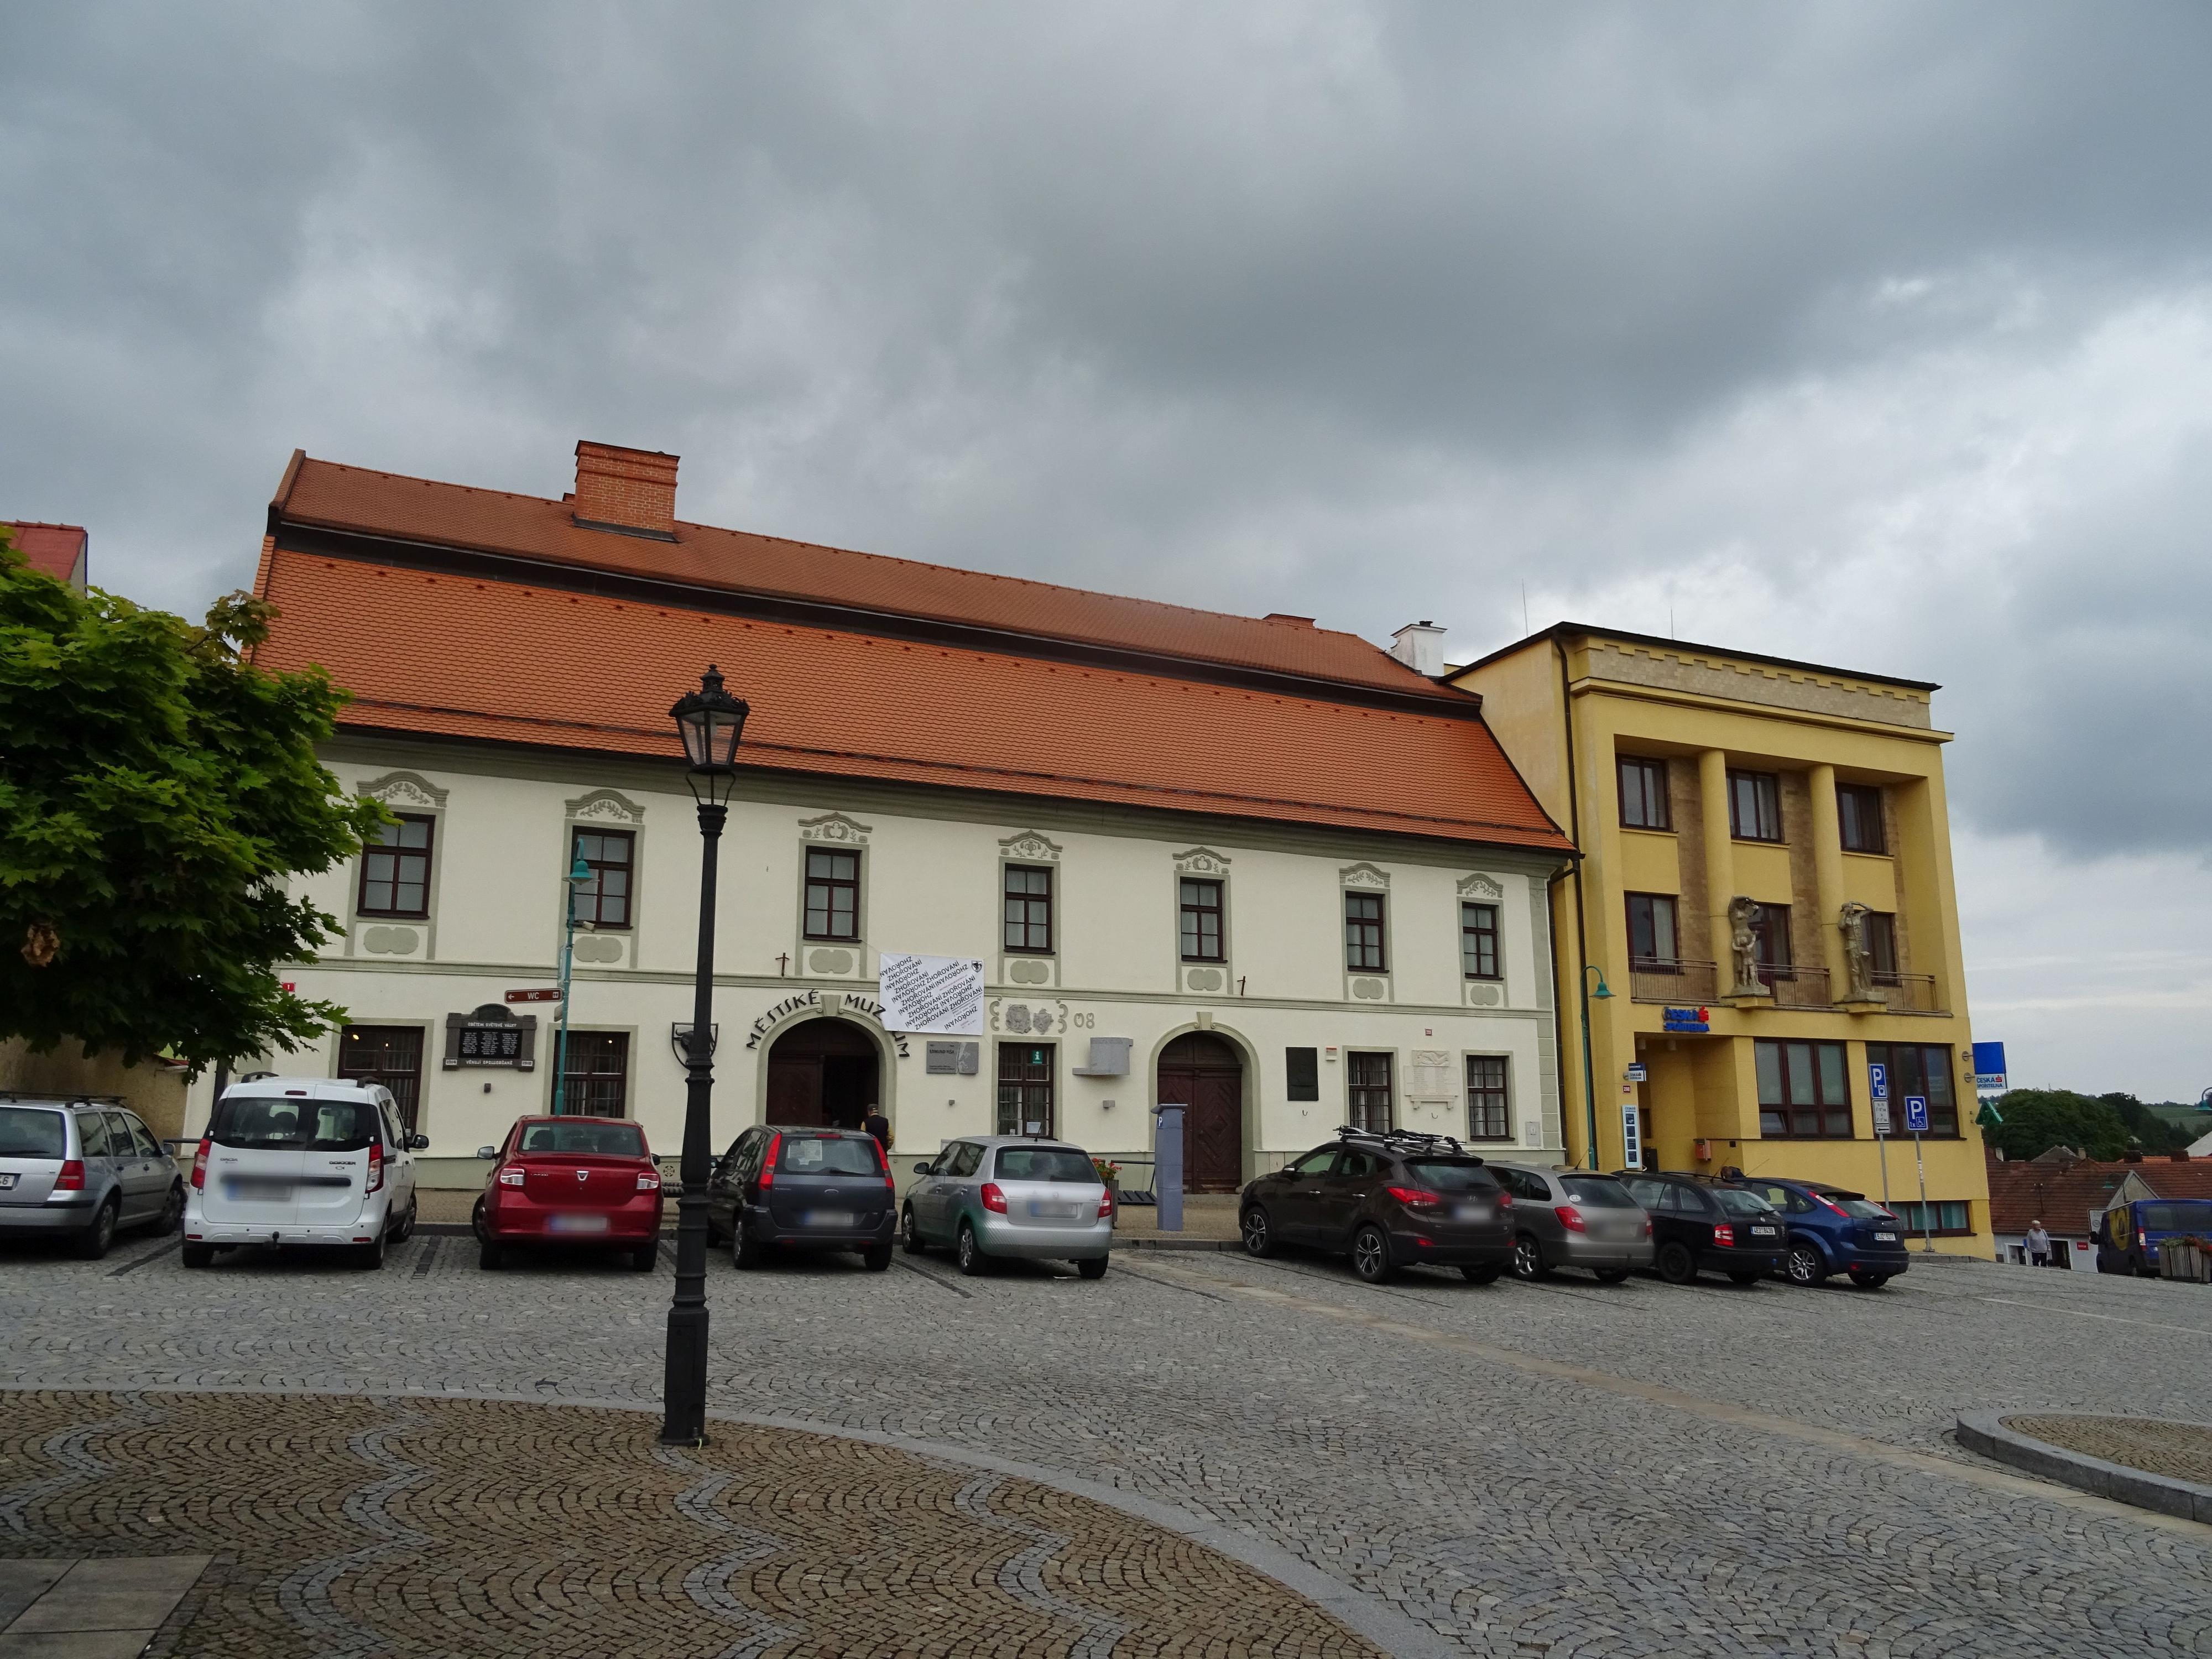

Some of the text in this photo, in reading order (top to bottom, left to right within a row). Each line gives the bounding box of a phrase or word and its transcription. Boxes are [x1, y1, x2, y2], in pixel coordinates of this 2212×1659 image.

[880, 956, 912, 977] ZHOŘOVÁN
[887, 958, 922, 982] ZHOŘOVÁNÍ
[885, 968, 919, 992] ZHOŘOVÁNÍ
[891, 980, 926, 1004] ZHOŘOVÁNÍ
[926, 960, 959, 983] ZHOŘOVÁNÍ
[894, 971, 929, 994] ZHOŘOVÁNÍ
[901, 982, 936, 1006] ZHOŘOVÁNÍ
[935, 964, 968, 987] ZHOŘOVÁNÍ
[898, 992, 933, 1016] ZHOŘOVÁNÍ
[905, 1004, 940, 1028] ZHOŘOVÁNÍ
[940, 984, 973, 1008] ZHOŘOVÁNÍ
[907, 993, 942, 1018] ZHOŘOVÁNÍ
[942, 974, 975, 998] ZHOŘOVÁNÍ
[915, 1006, 949, 1030] ZHOŘOVÁNÍ
[949, 985, 983, 1010] ZHOŘOVÁNÍ
[746, 988, 910, 1057] MĚSTSKÉ MUZUM
[944, 1006, 978, 1030] ZHOŘOVÁNÍ
[1074, 1013, 1095, 1029] 08
[1872, 1068, 1882, 1088] P
[1159, 1117, 1162, 1126] P
[1910, 1100, 1922, 1120] P
